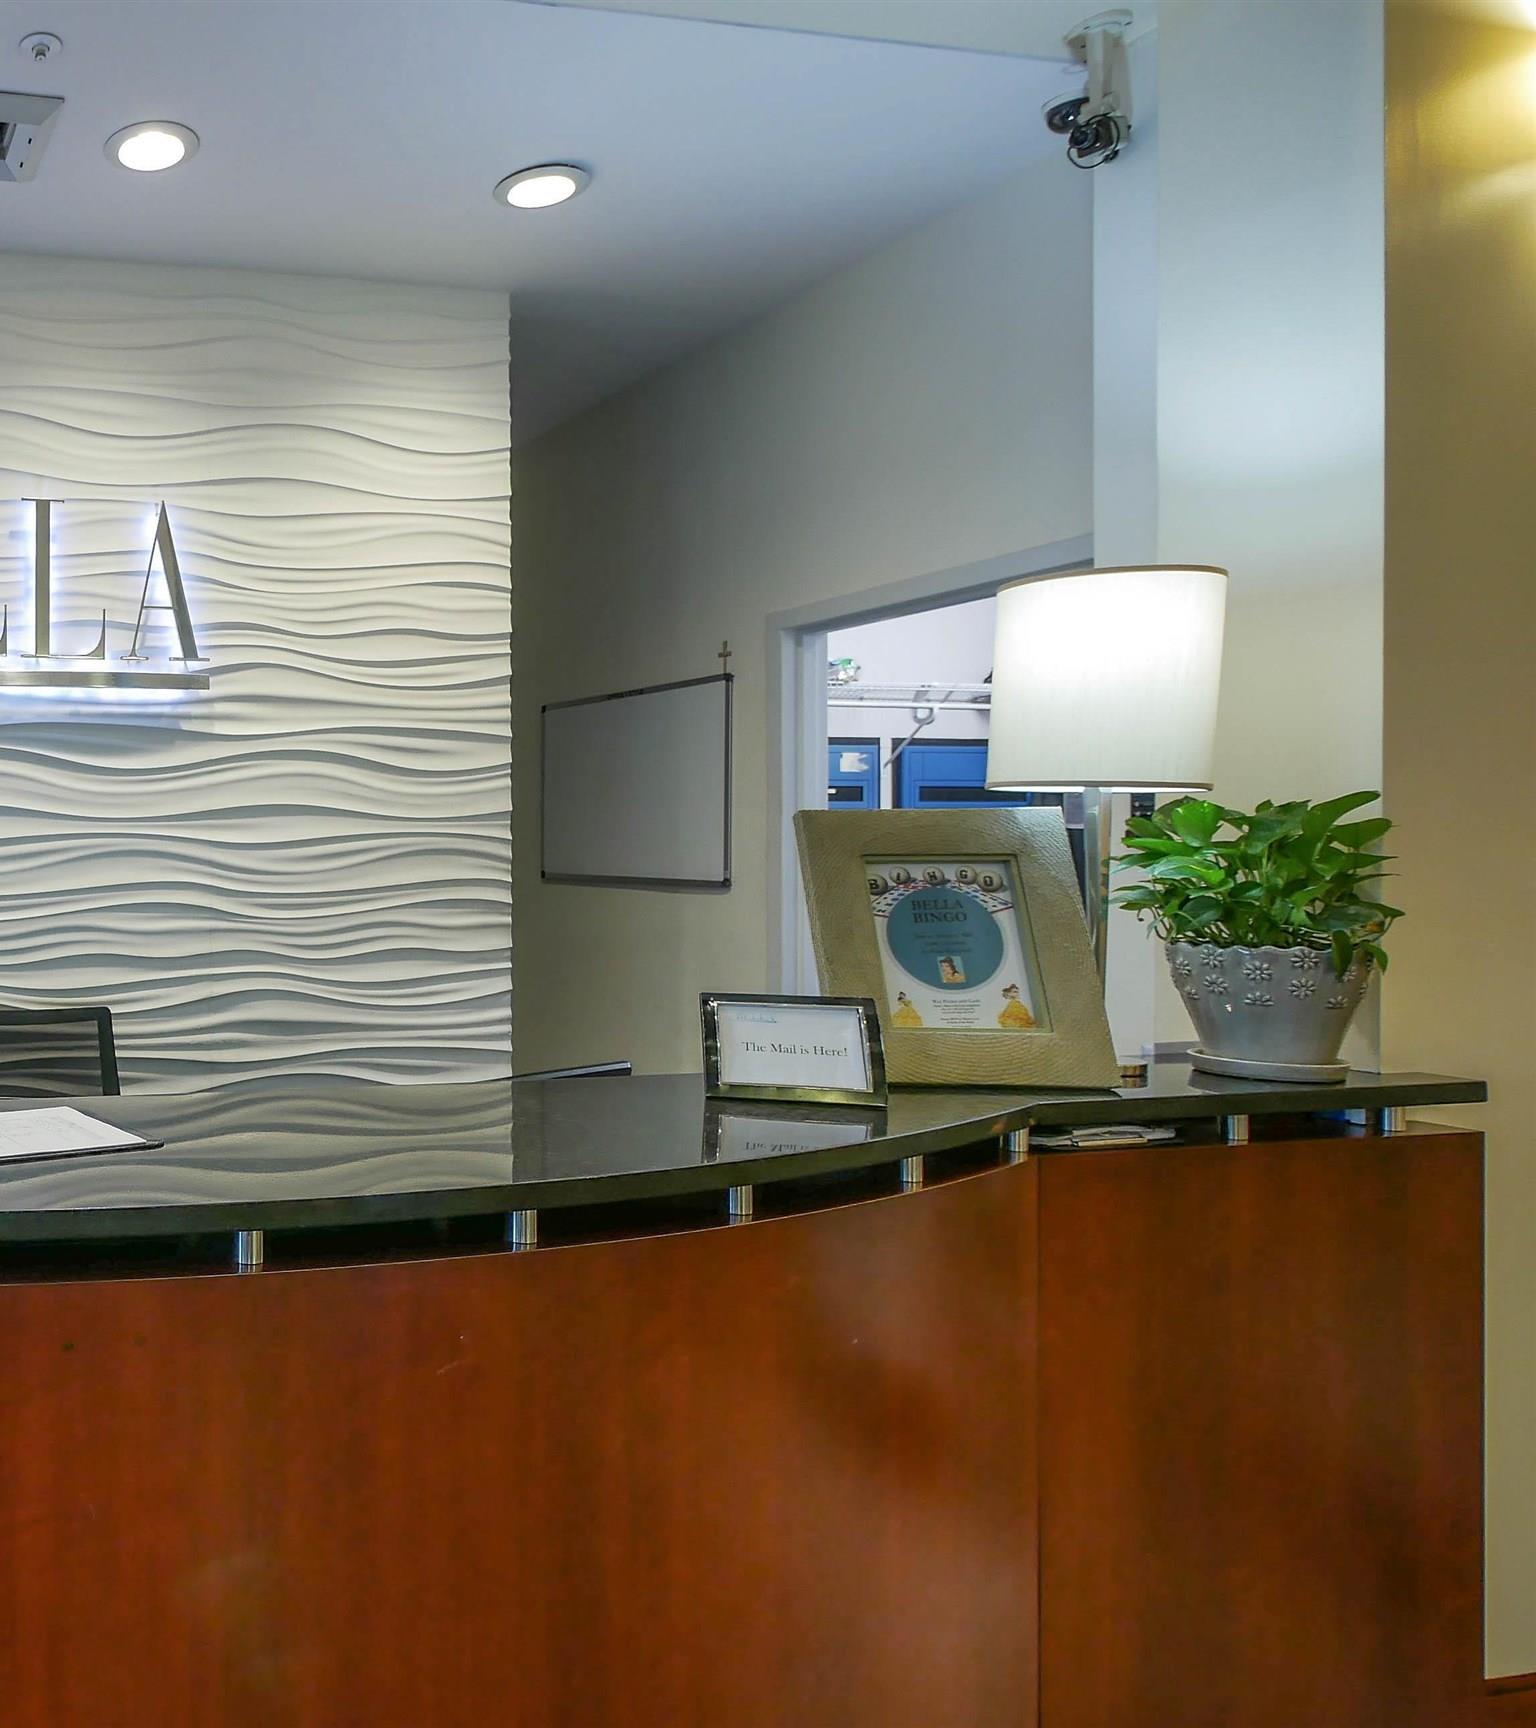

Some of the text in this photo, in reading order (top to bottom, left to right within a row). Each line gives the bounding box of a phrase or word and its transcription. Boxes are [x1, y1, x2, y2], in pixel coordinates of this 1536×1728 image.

[911, 899, 964, 911] BELLA
[913, 911, 968, 924] BINGO
[741, 1041, 848, 1057] The Mail is Here!
